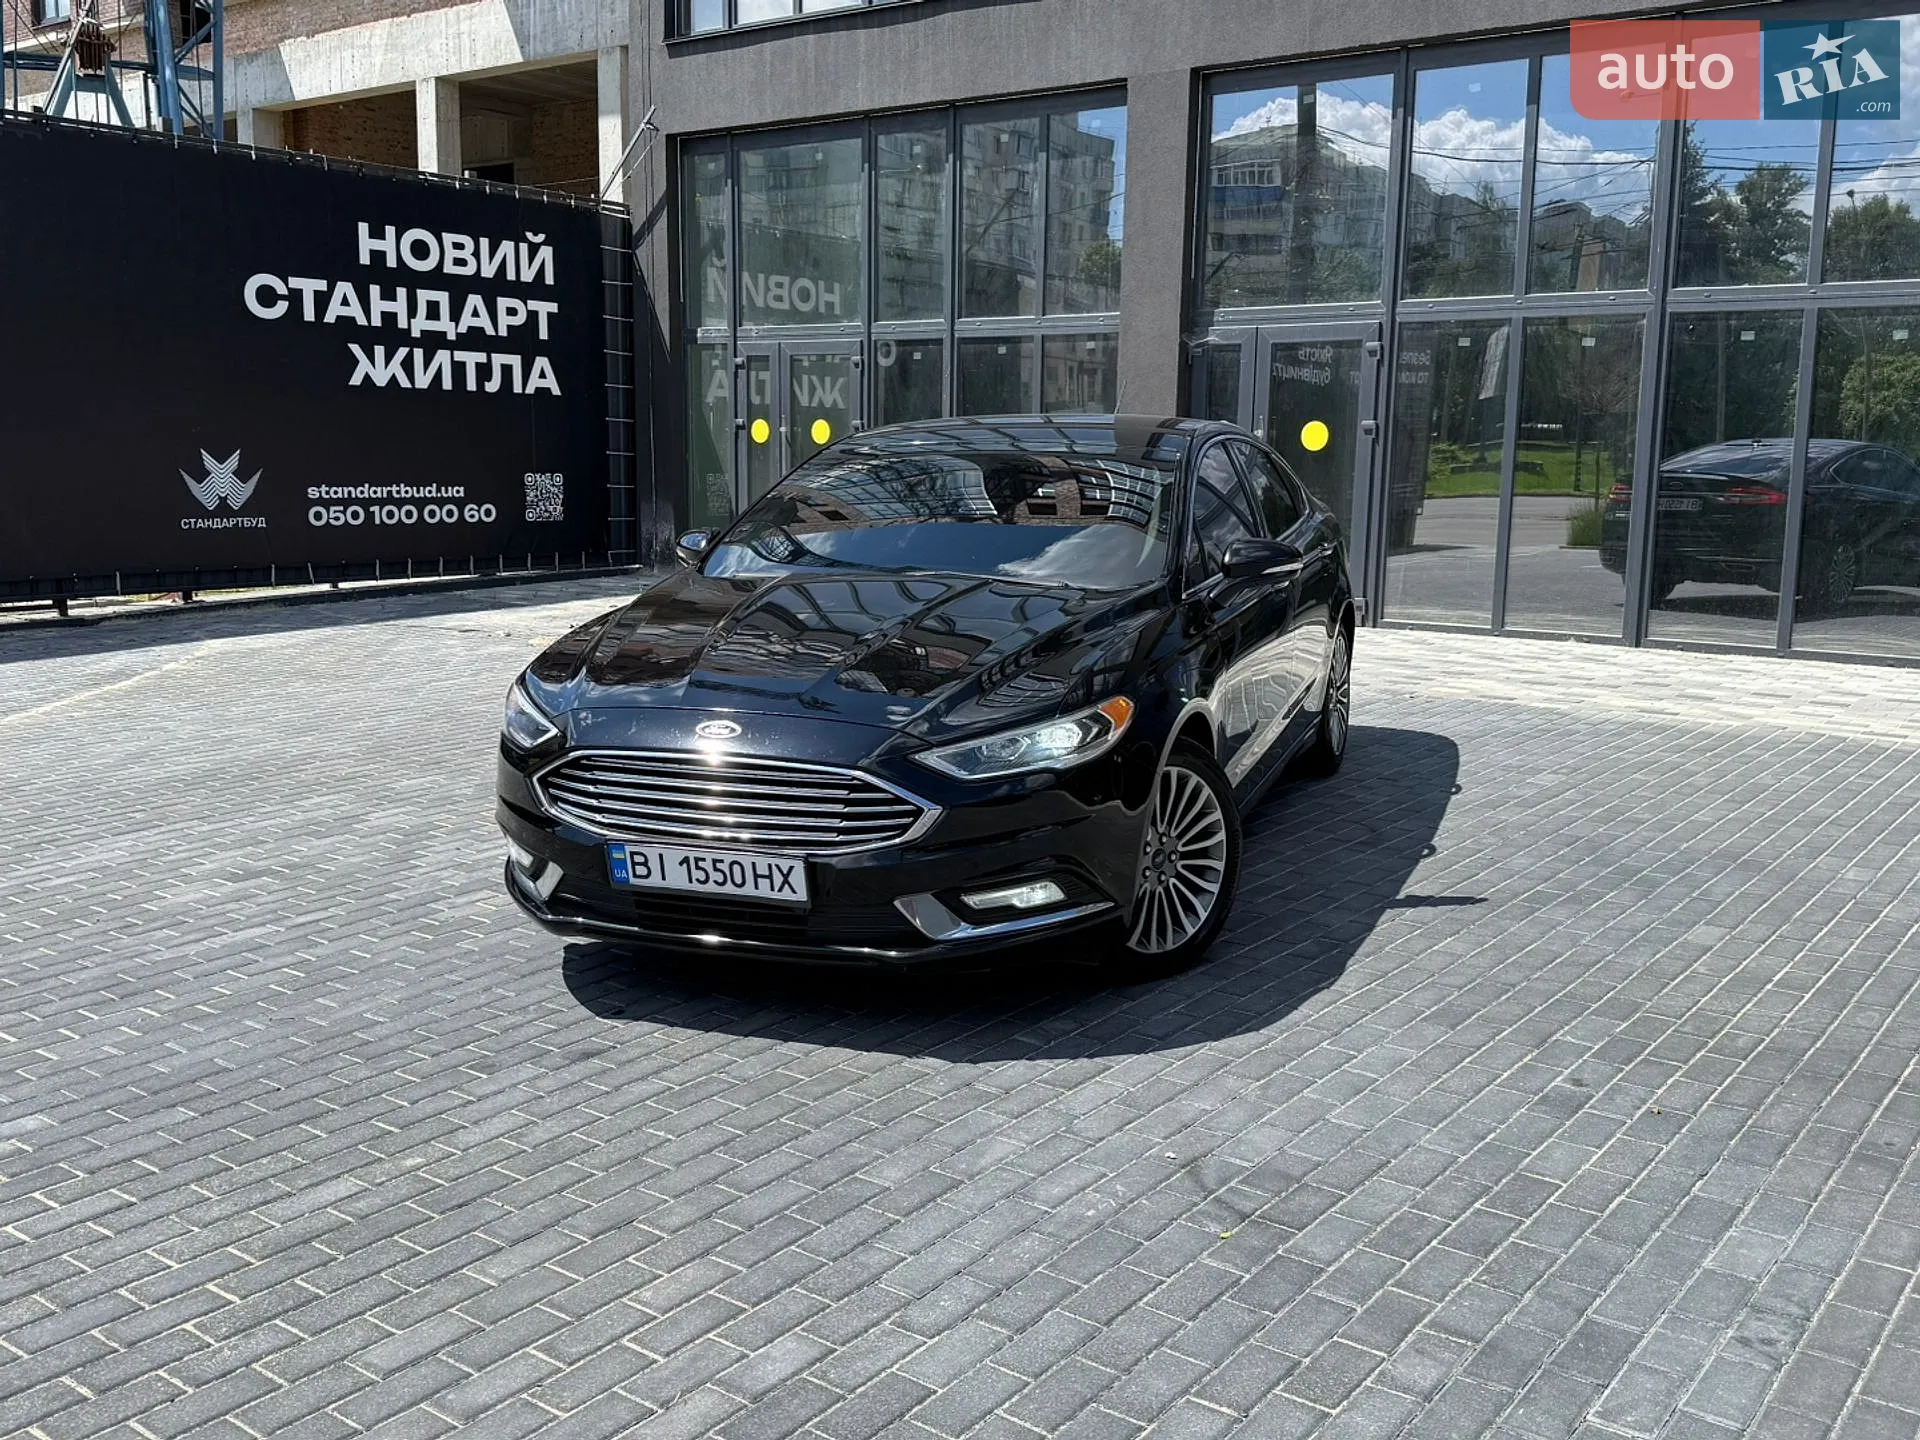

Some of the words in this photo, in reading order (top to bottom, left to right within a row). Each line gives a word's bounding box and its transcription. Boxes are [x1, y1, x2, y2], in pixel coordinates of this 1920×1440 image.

[357, 221, 555, 286] НОВИЙ
[243, 273, 559, 341] СТАНДАРТ
[347, 343, 562, 396] ЖИТЛА
[307, 483, 465, 499] standartbud.ua
[181, 516, 267, 530] СТАНДАРТБУД
[308, 504, 365, 527] 050
[369, 504, 418, 525] 100
[423, 504, 459, 524] 00
[463, 503, 497, 523] 60
[614, 868, 628, 879] UA
